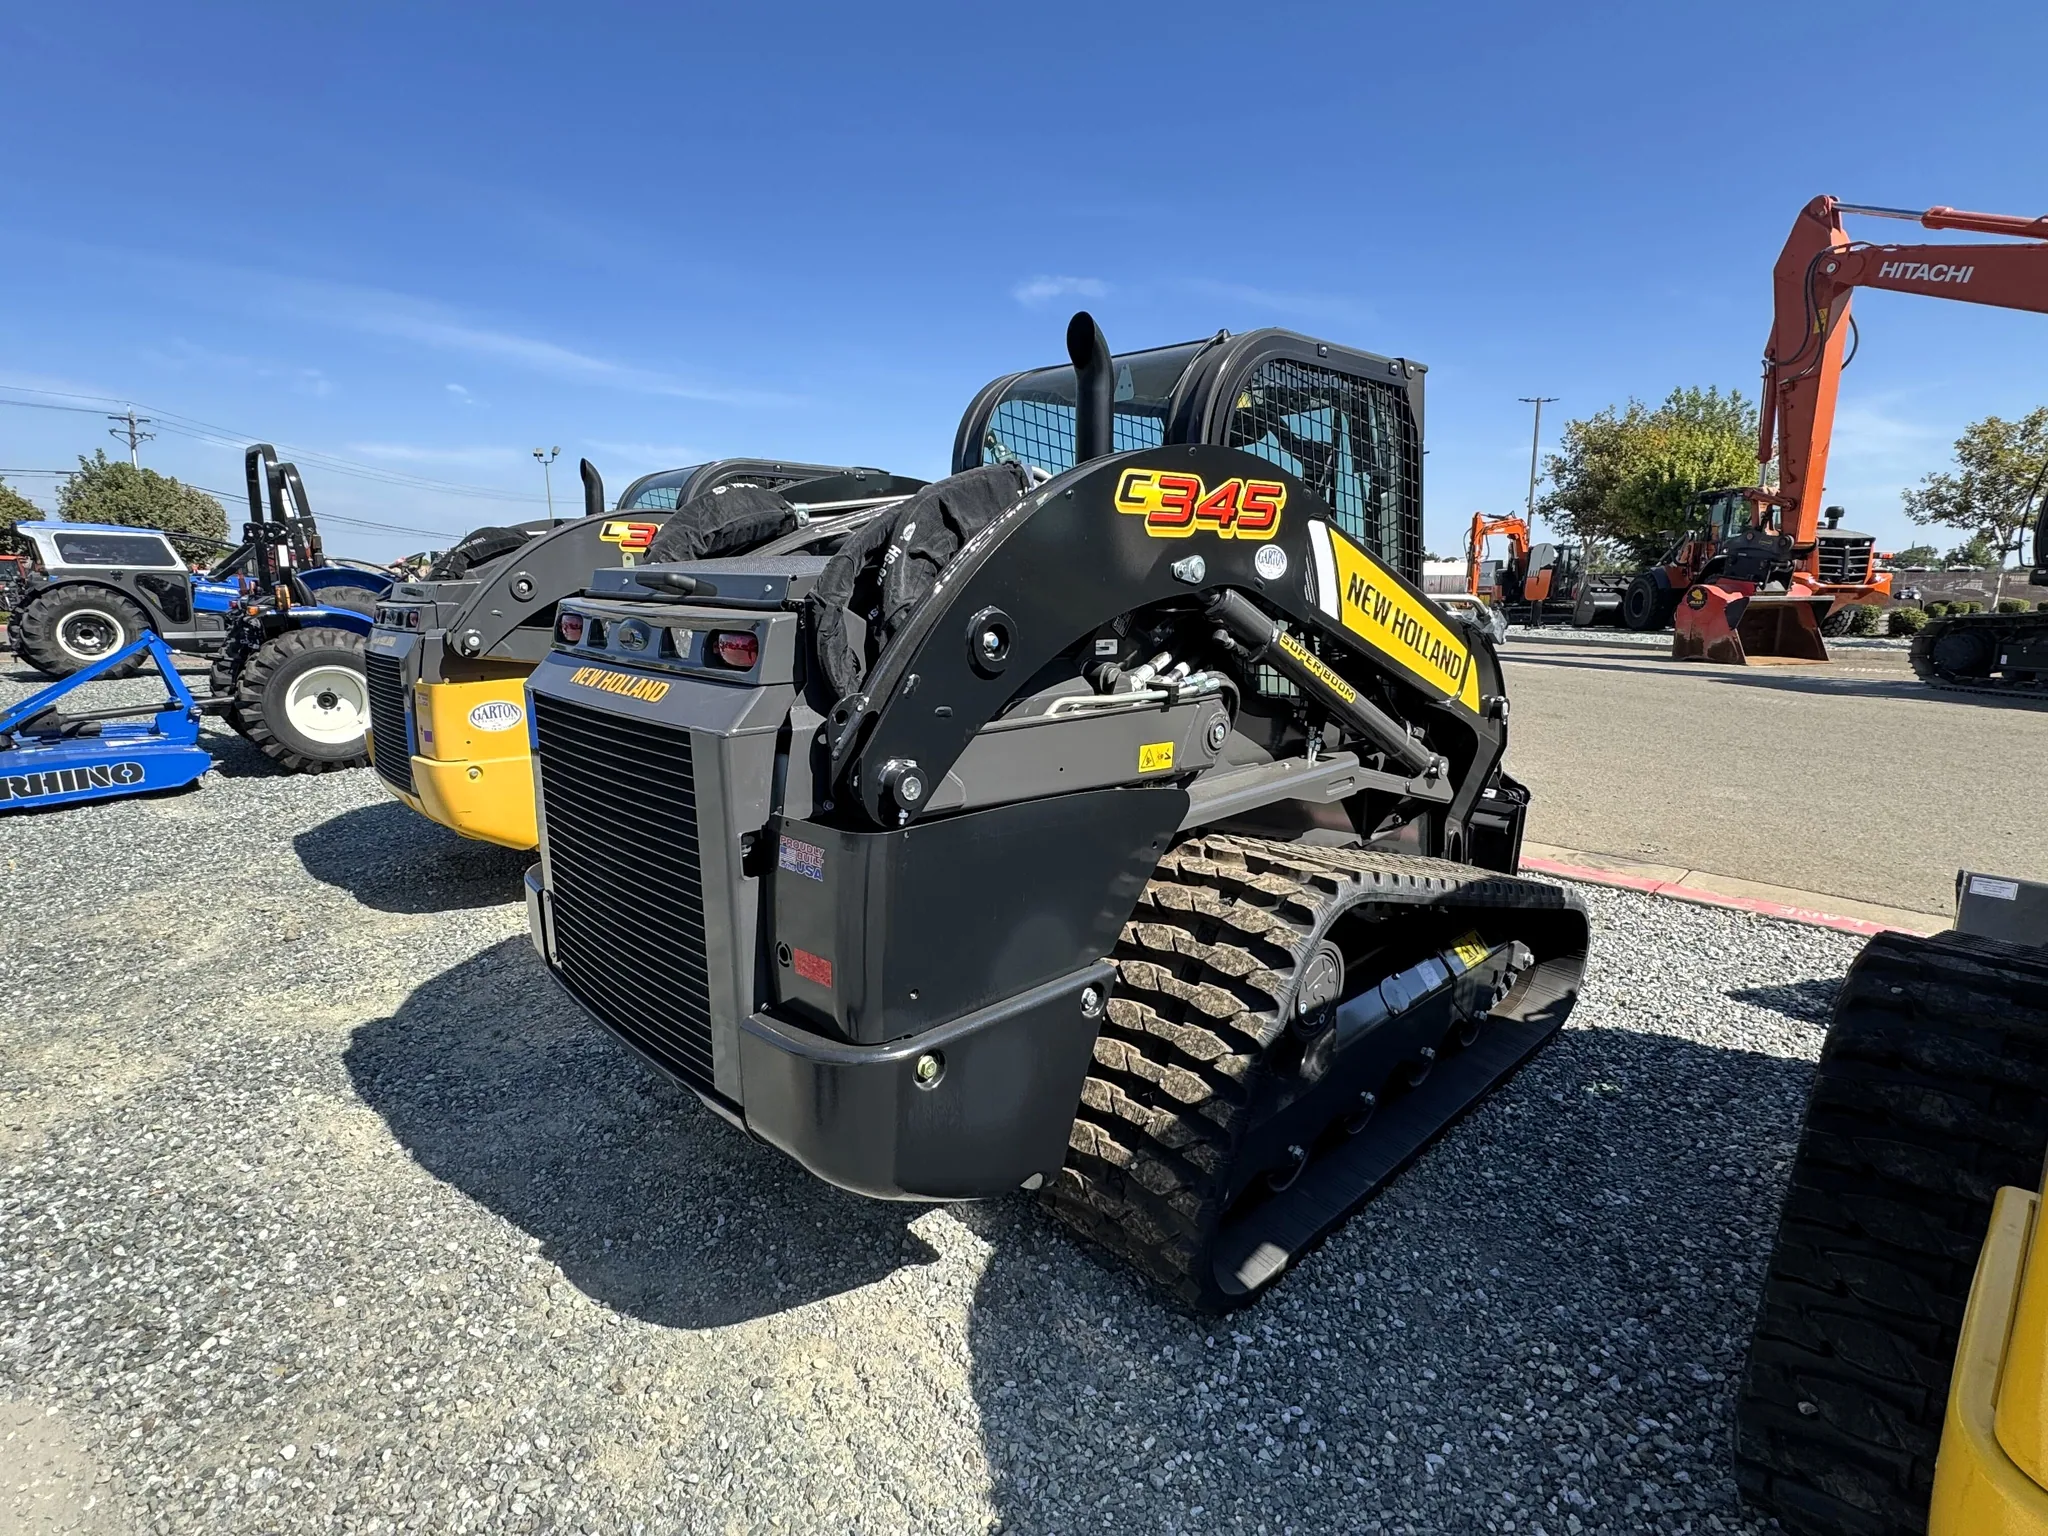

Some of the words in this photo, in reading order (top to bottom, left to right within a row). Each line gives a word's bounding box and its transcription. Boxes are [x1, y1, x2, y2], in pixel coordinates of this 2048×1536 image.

[1878, 261, 1975, 284] HITACHI
[1117, 470, 1285, 538] C345
[600, 522, 662, 551] L3
[1346, 571, 1393, 627] NEW
[1391, 606, 1462, 681] HOLLAND
[1280, 633, 1323, 674] SUPER
[1321, 668, 1356, 702] BOOM
[569, 666, 608, 688] NEW
[596, 671, 670, 703] HOLLAND
[471, 703, 520, 722] GARTON
[0, 762, 145, 800] RHINO
[780, 835, 825, 857] PROUDLY
[796, 850, 824, 868] BUILT
[796, 861, 824, 882] USA
